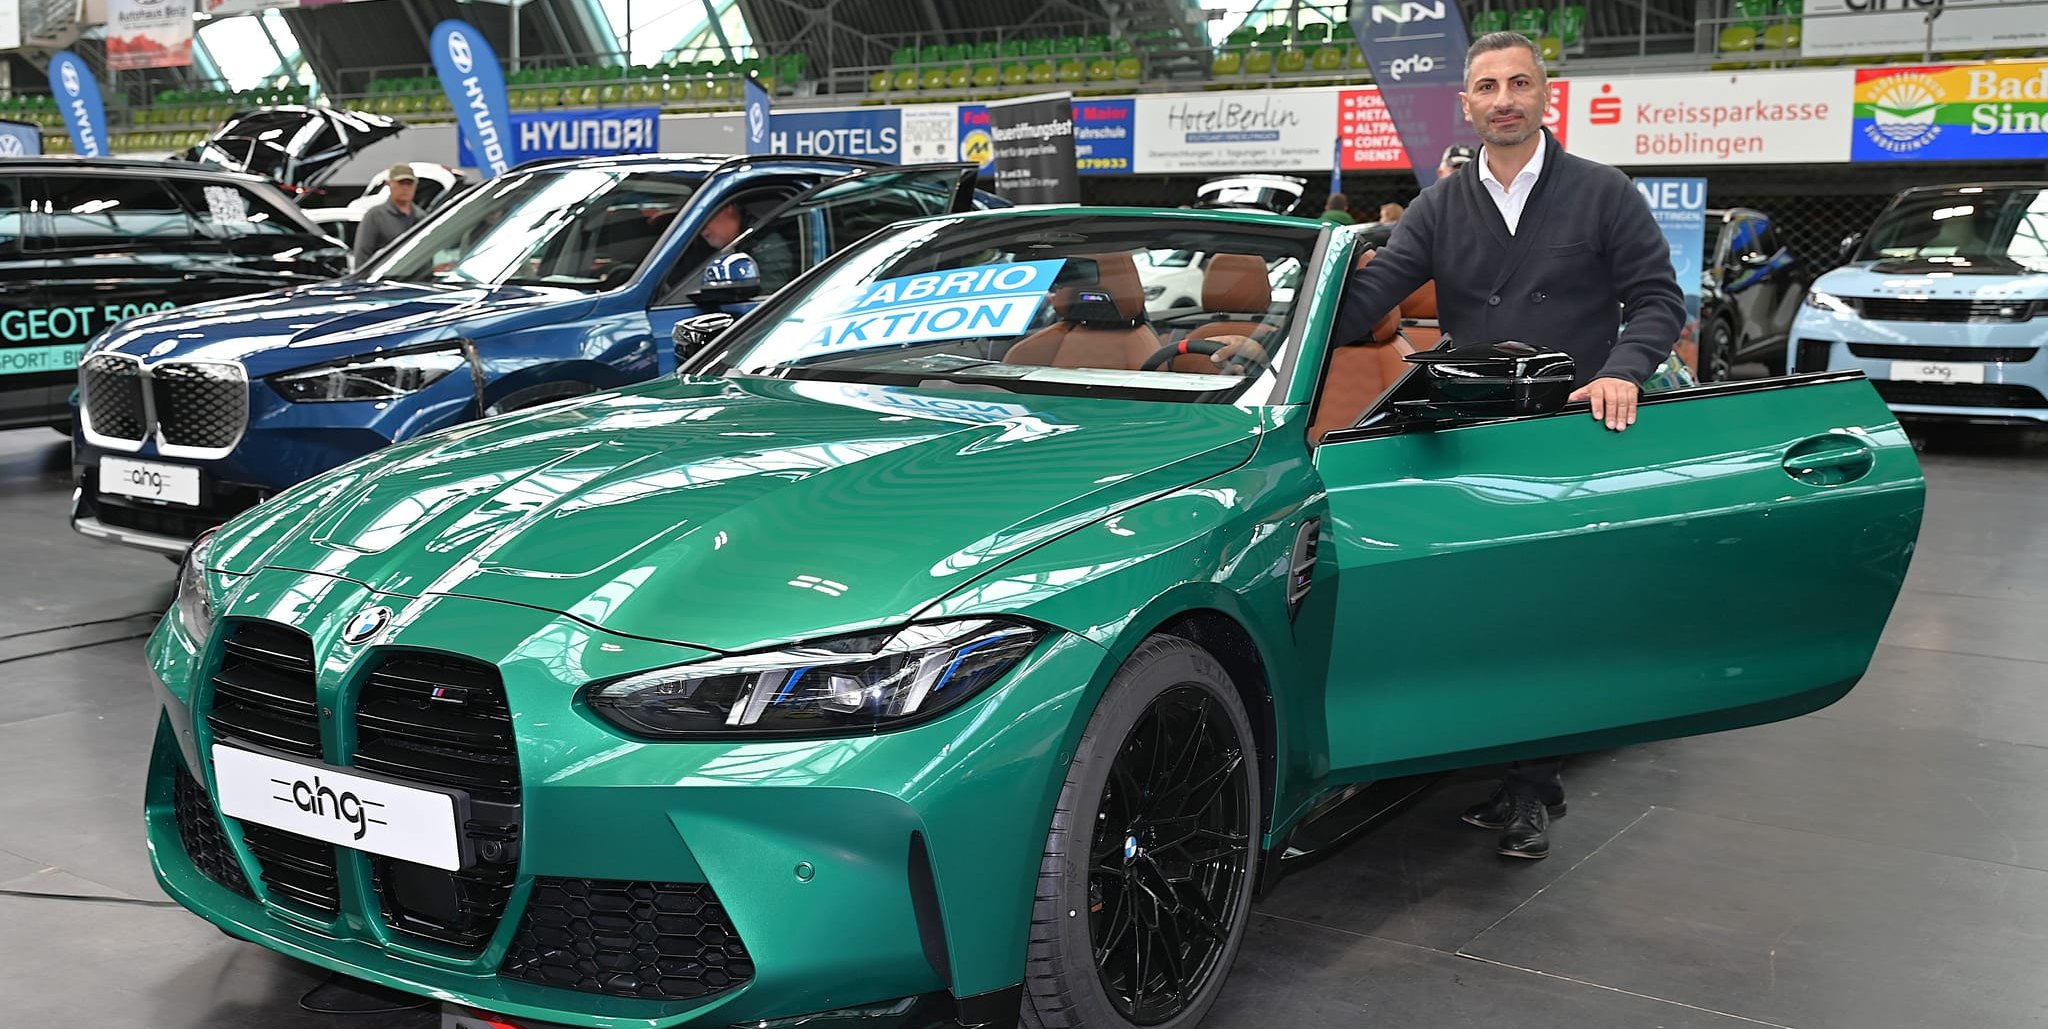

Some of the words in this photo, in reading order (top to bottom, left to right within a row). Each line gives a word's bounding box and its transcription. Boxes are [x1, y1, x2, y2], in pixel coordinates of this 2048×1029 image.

[1083, 108, 1128, 121] Maier
[1636, 101, 1830, 128] Kreissparkasse
[520, 118, 654, 151] HYUNDAI
[796, 127, 897, 156] HOTELS
[1635, 131, 1764, 159] Böblingen
[1354, 150, 1400, 162] DIENST
[1637, 182, 1704, 210] NEU
[810, 303, 1012, 347] AKTION
[1922, 363, 1951, 379] ahg
[131, 466, 162, 495] ahg
[292, 776, 367, 840] ahg
